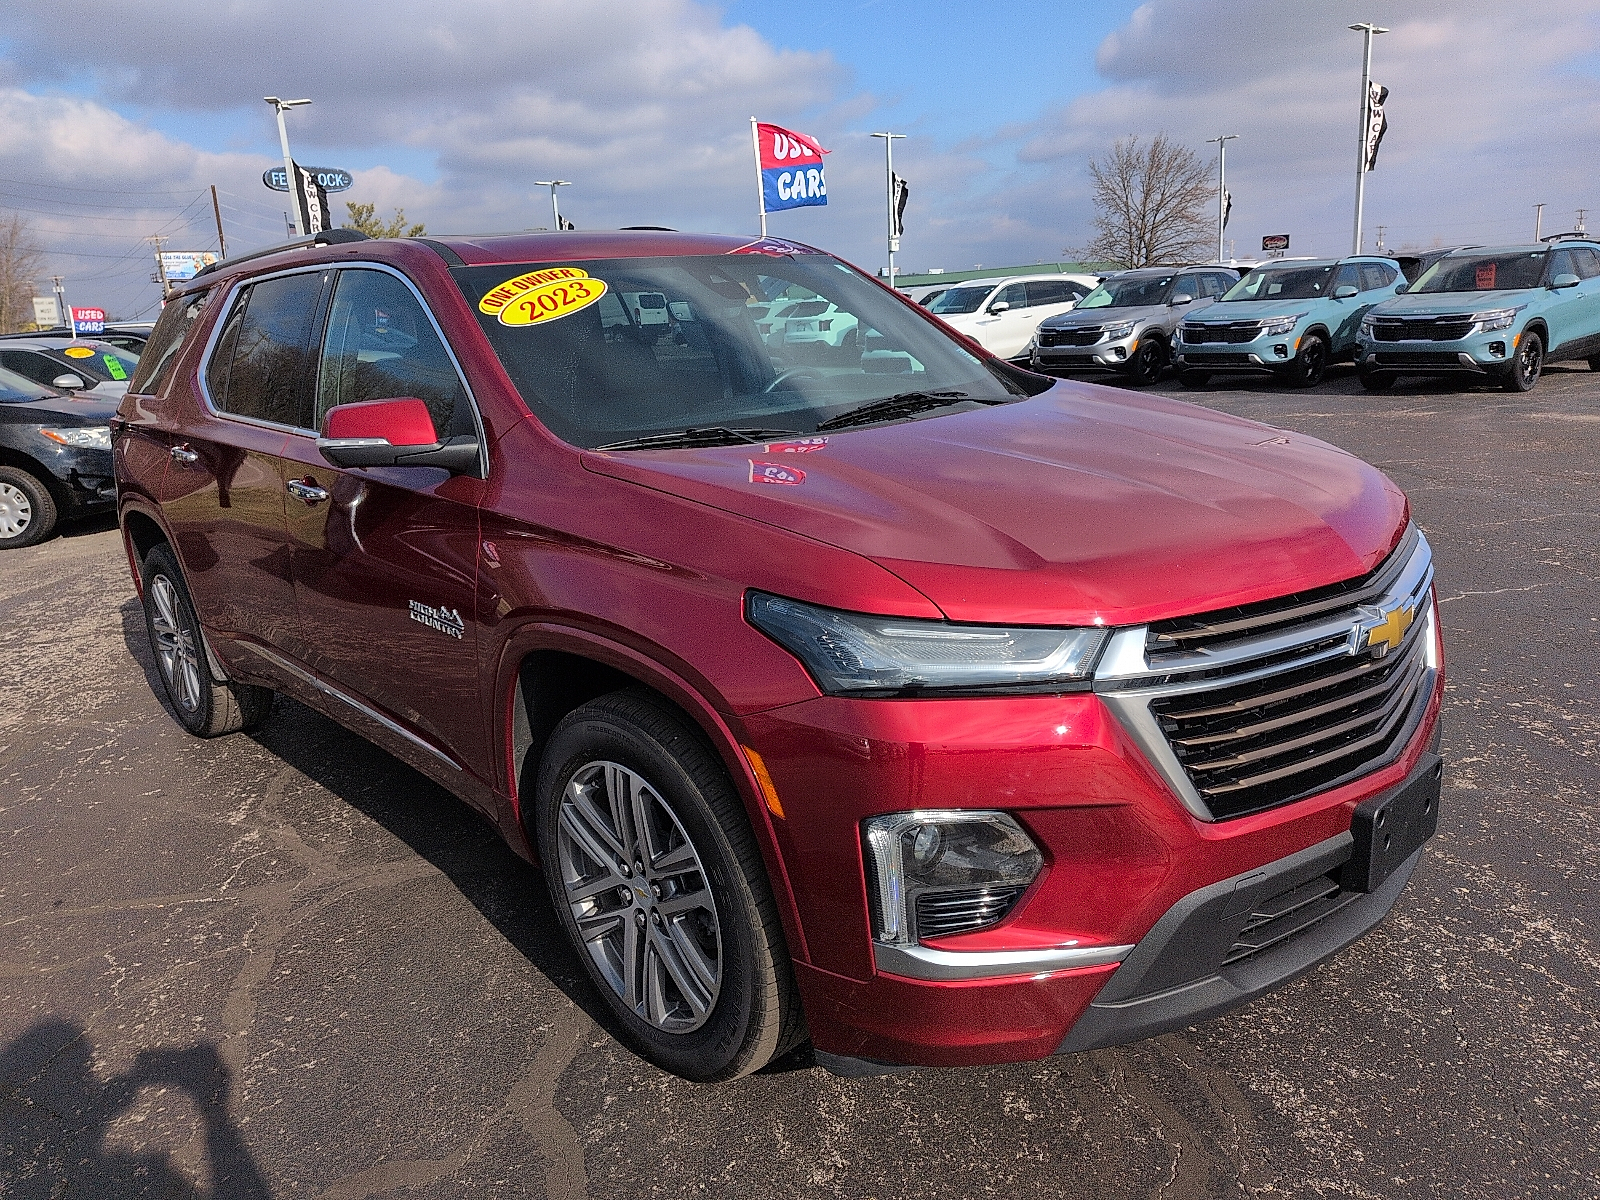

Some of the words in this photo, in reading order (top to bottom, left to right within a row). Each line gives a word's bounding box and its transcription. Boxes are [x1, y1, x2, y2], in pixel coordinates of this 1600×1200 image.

[483, 286, 518, 307] ONE
[512, 268, 575, 290] OWNER
[519, 281, 591, 321] 2023
[77, 309, 104, 320] USED
[79, 321, 105, 332] CARS
